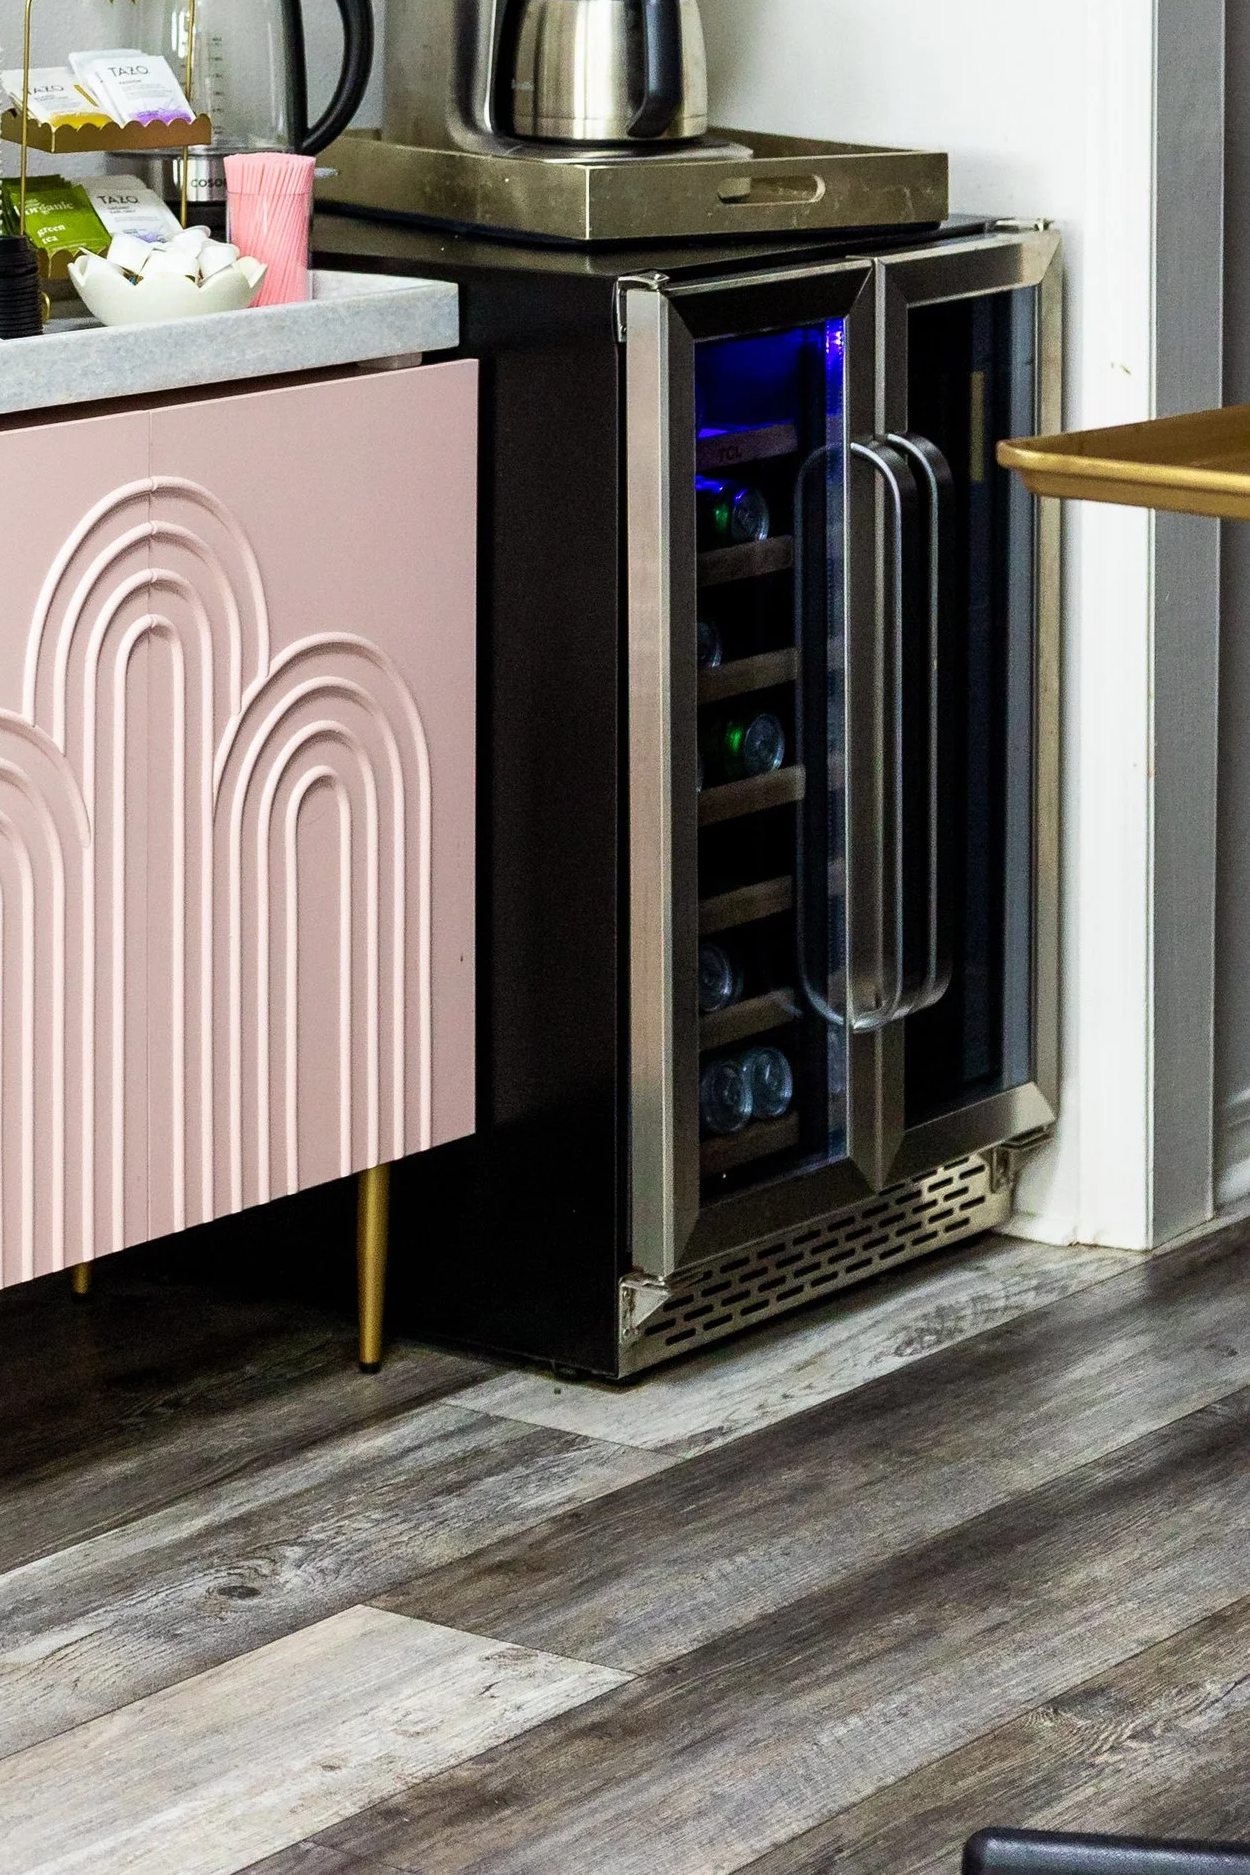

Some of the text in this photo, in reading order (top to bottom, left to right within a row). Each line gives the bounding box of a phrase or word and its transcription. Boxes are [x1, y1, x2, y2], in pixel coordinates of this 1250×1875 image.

[108, 65, 149, 77] TAZO
[191, 178, 227, 189] COSO
[97, 195, 139, 205] TAZO
[36, 224, 66, 238] green
[41, 235, 58, 245] tea
